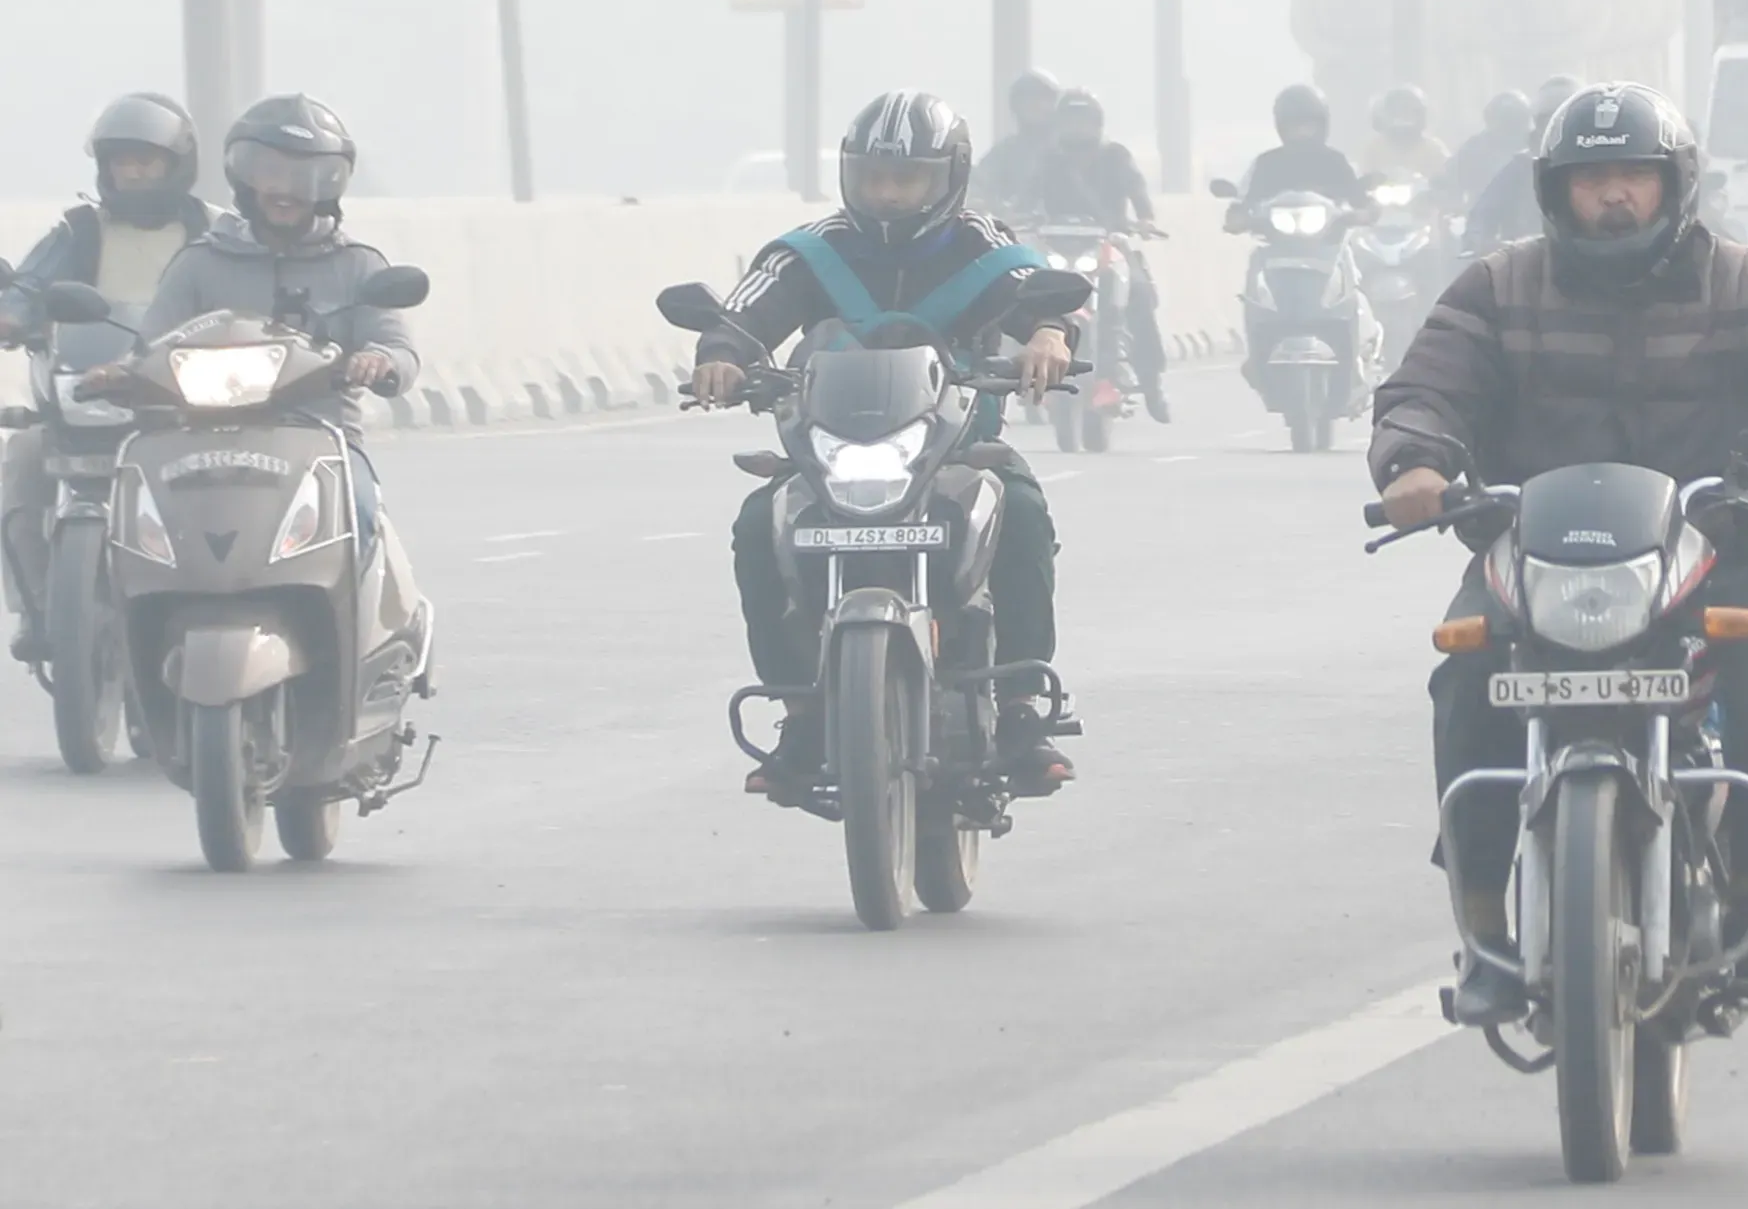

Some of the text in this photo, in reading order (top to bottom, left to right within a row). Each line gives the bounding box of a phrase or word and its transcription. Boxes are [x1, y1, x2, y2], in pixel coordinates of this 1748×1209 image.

[813, 528, 940, 545] DL 14SX 8034
